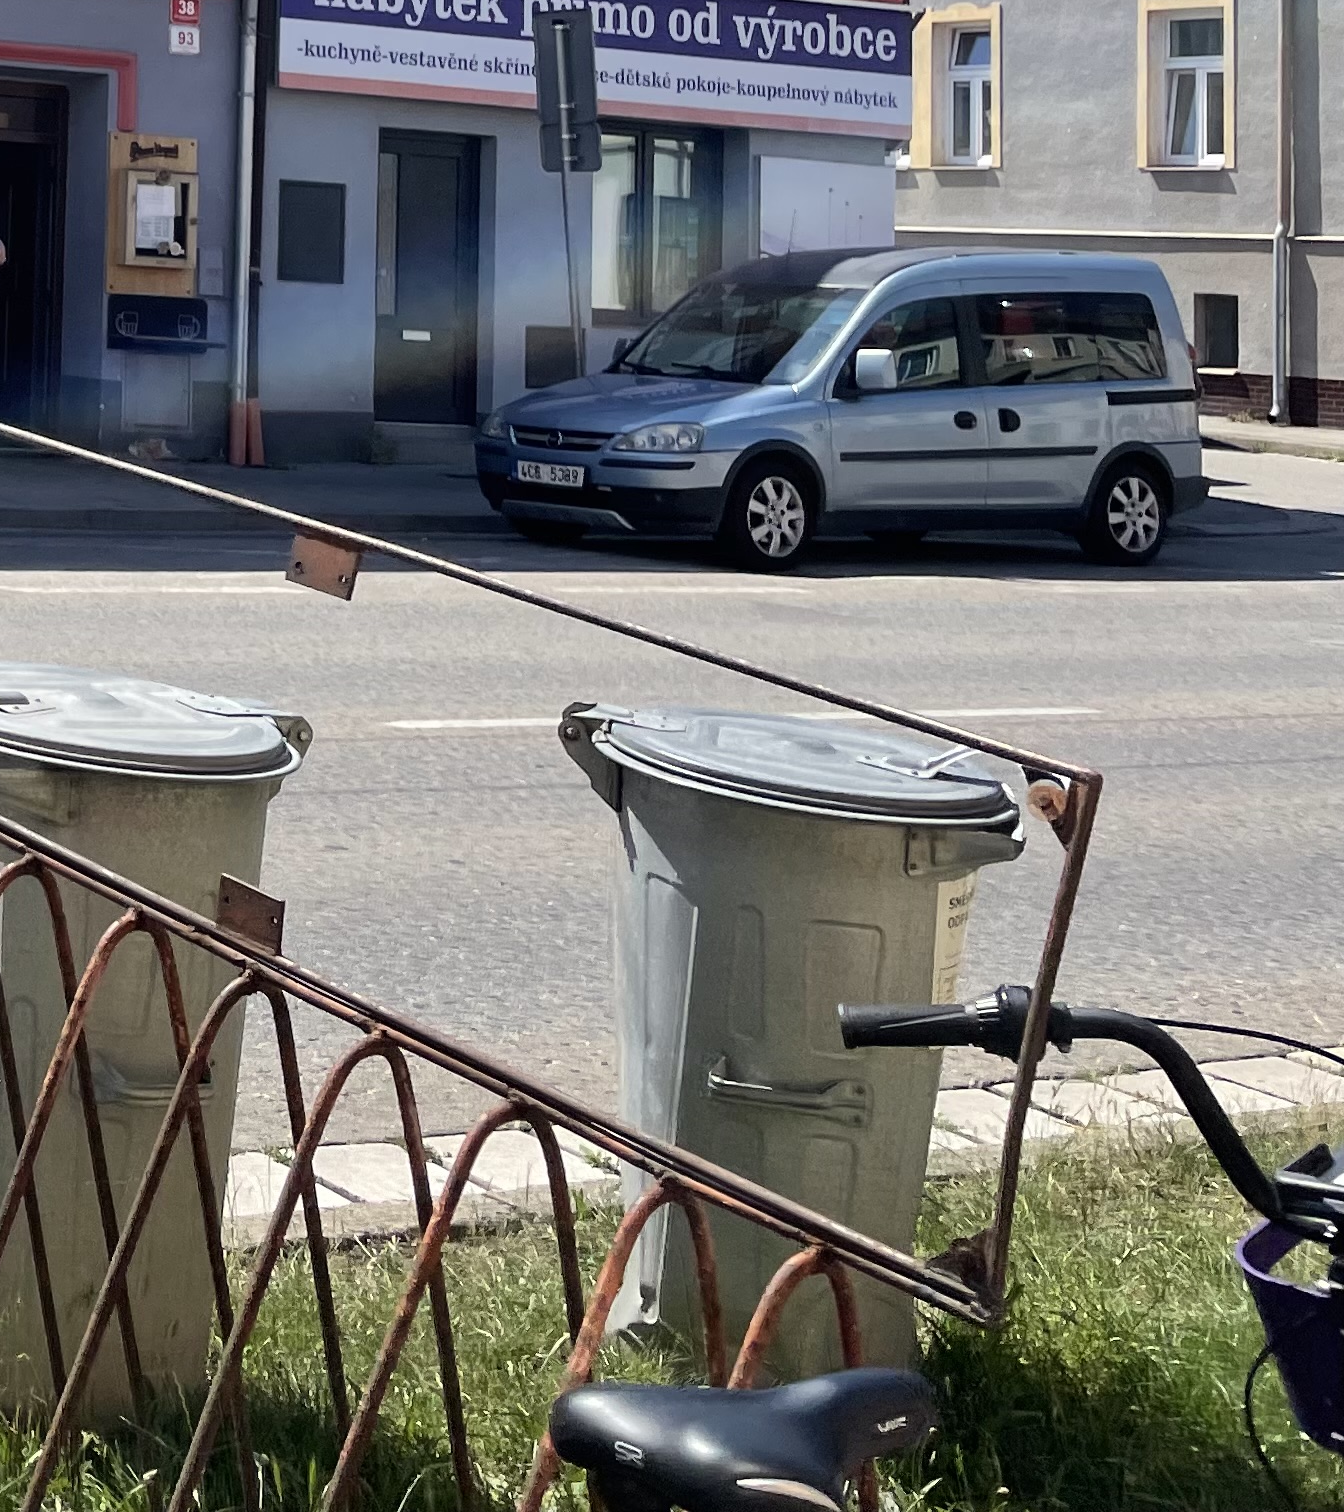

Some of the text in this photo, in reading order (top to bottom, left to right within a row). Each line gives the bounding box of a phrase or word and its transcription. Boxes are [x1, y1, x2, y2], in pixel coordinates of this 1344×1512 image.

[178, 0, 195, 16] 38
[178, 31, 194, 46] 93
[668, 1, 720, 45] od
[732, 5, 898, 62] výrobce
[297, 40, 479, 72] -kuchyně-vestavěné
[676, 74, 829, 106] pokoje-koupelnový
[834, 88, 899, 110] nábytek
